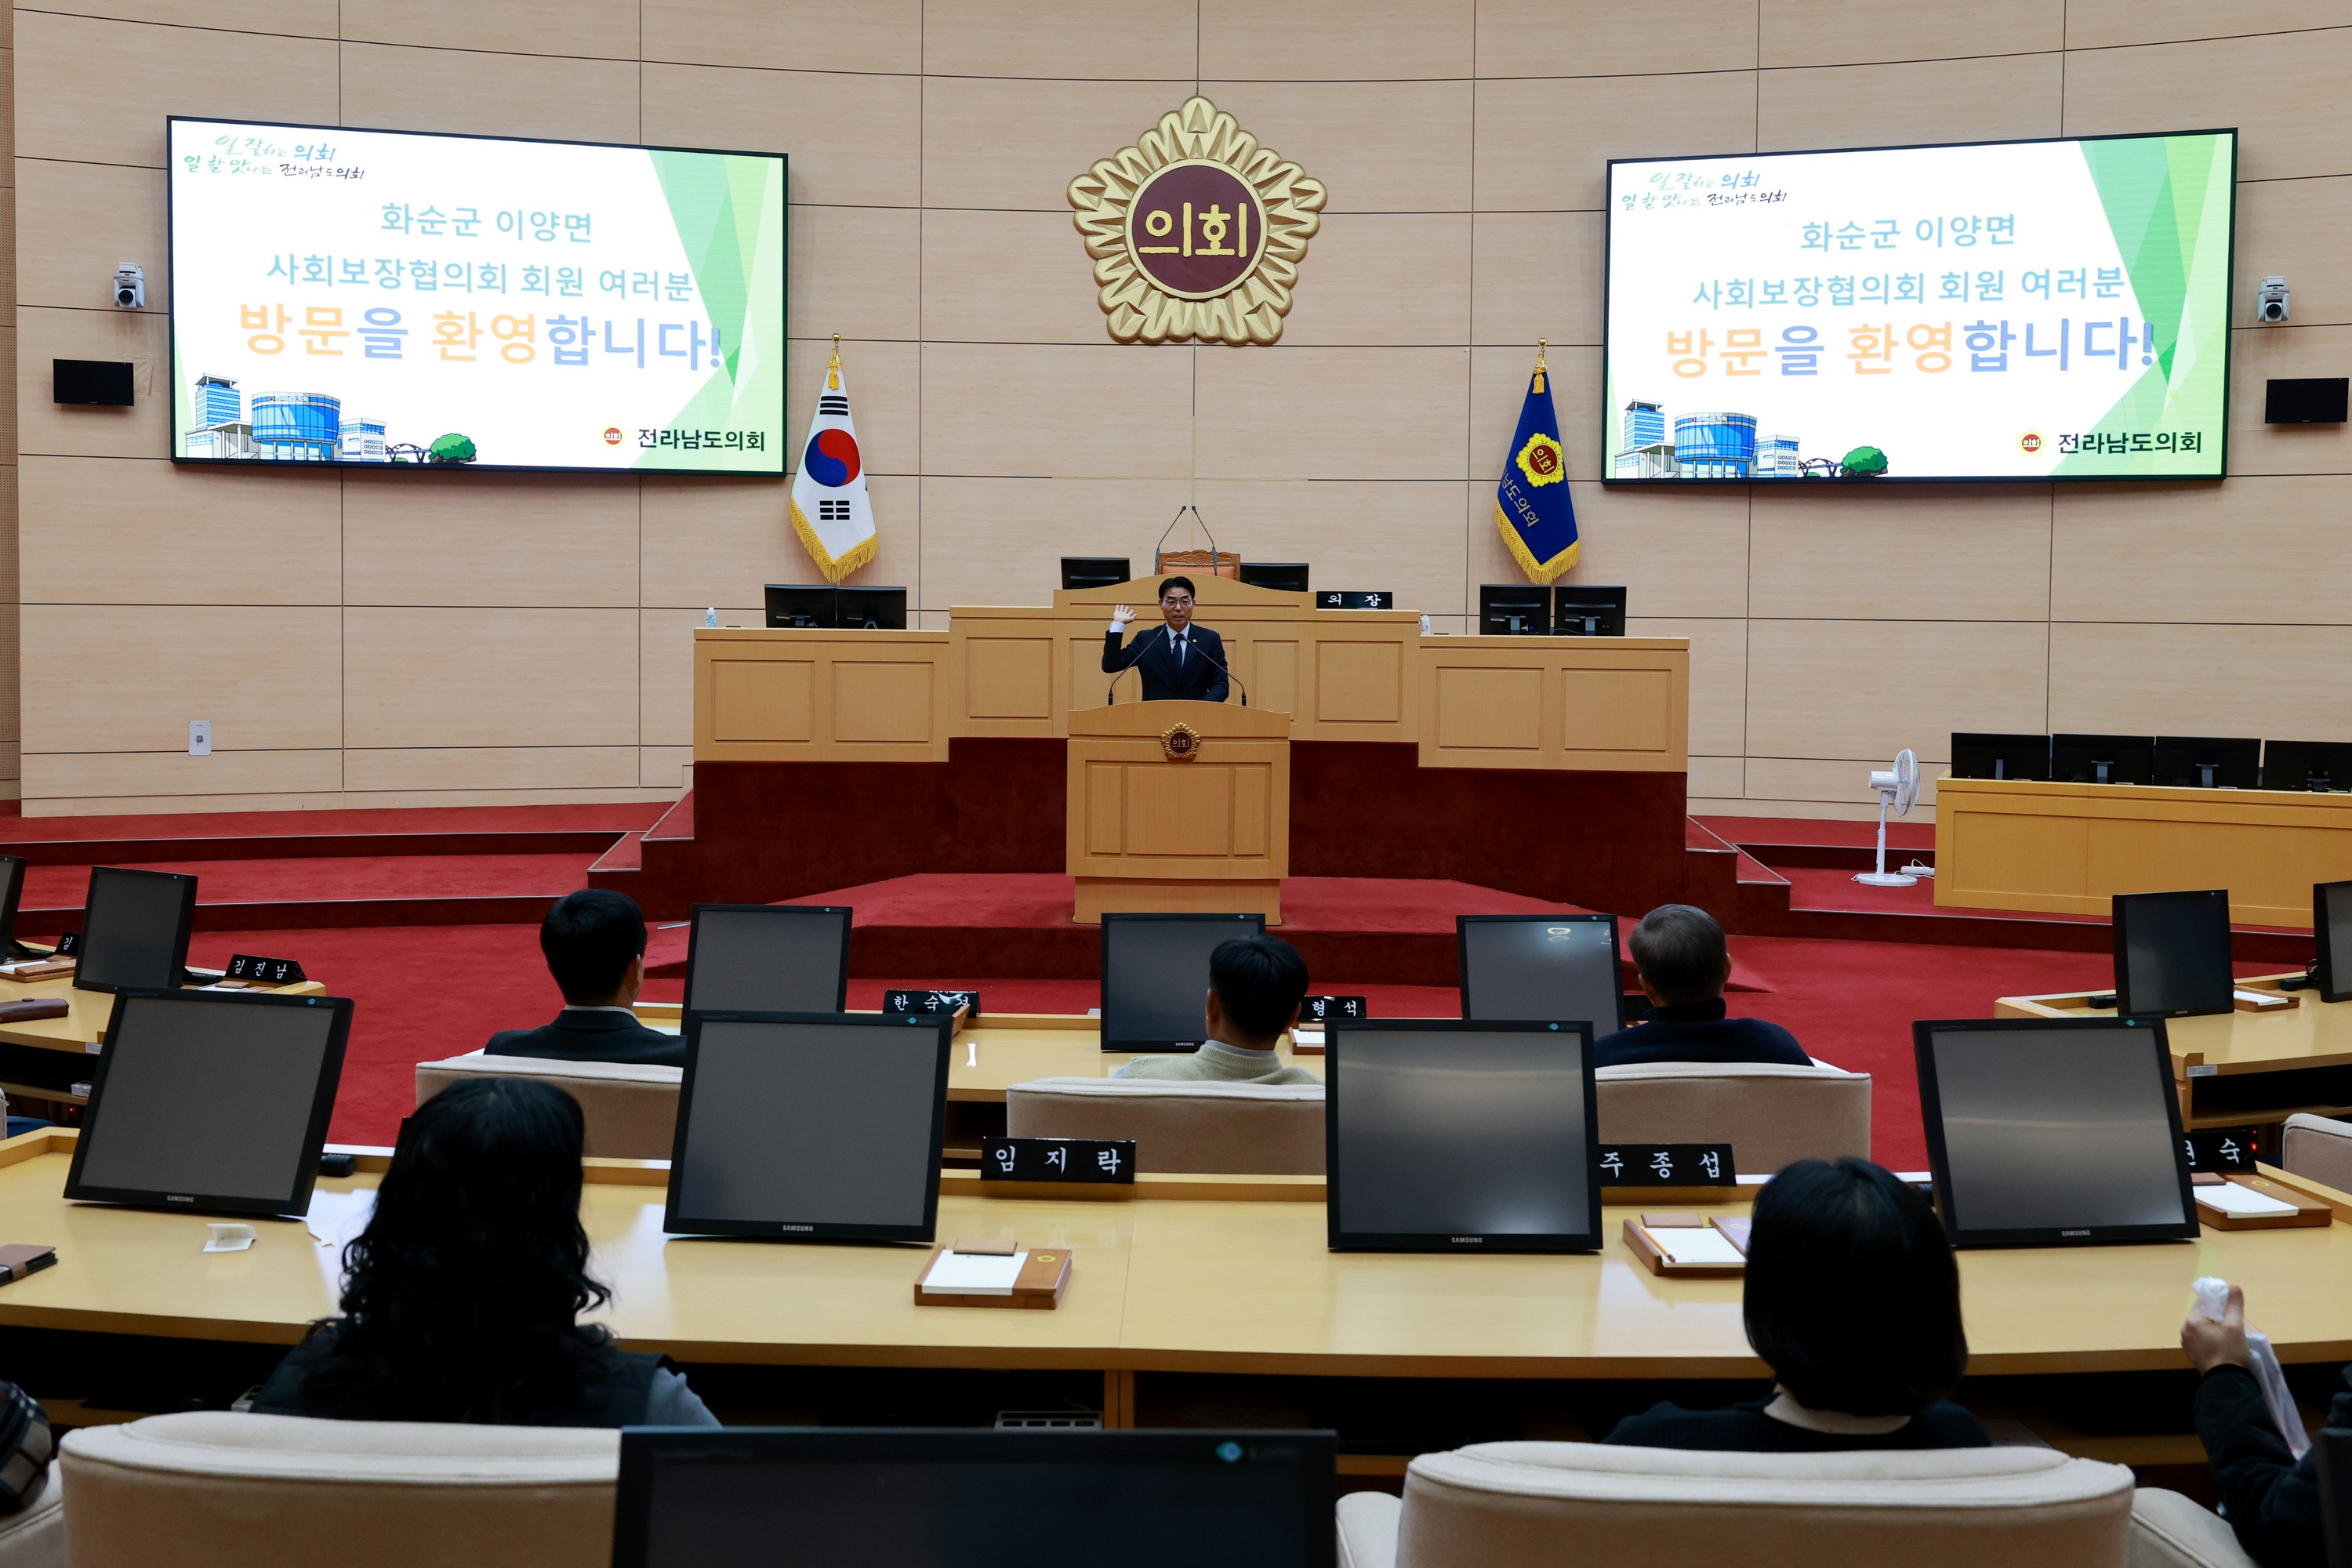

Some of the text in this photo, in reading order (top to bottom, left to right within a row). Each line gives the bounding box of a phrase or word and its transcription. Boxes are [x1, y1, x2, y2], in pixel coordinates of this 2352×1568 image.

[293, 143, 336, 162] 의회
[279, 163, 365, 180] 전라남도의회
[1721, 170, 1761, 189] 의회
[1707, 190, 1788, 206] 전라남도의회
[380, 201, 593, 244] 화순군 이양면
[1138, 201, 1247, 258] 의회
[1801, 213, 2016, 252] 화순군 이양면
[266, 252, 694, 303] 사회보장협의회 회원 여러분
[1693, 266, 2125, 310] 사회보장협의회 회원 여러분
[239, 303, 721, 372] 방문을 환영합니다!
[1666, 316, 2154, 379] 방문을 환영합니다!
[604, 432, 621, 441] 의회
[638, 428, 765, 452] 전라남도의회
[2023, 438, 2040, 448] 의회
[2058, 431, 2201, 454] 전라남도의회
[1532, 449, 1555, 474] 의회
[1171, 738, 1189, 748] 의회
